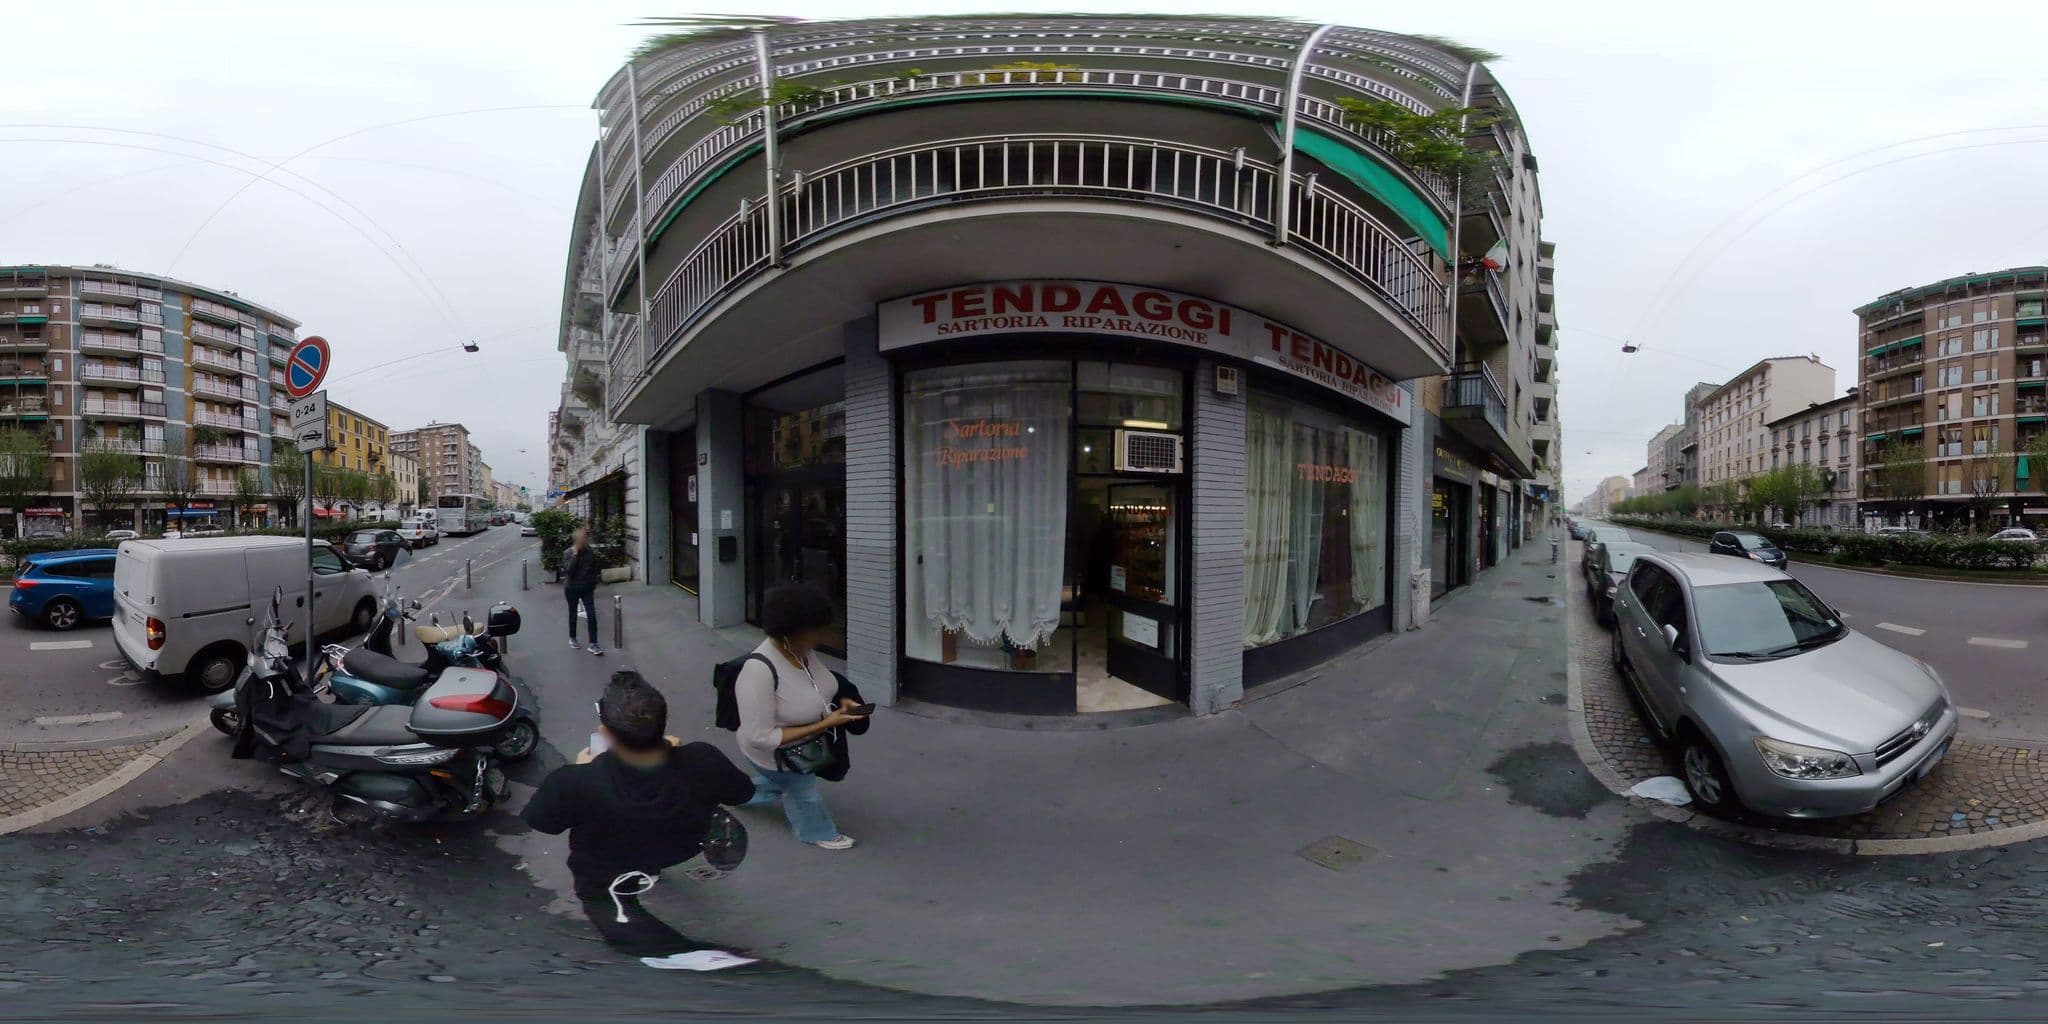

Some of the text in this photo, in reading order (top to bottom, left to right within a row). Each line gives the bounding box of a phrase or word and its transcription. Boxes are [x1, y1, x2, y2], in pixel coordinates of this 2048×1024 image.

[912, 285, 1230, 336] TENDAGGI
[937, 315, 1208, 345] SARTORIA RIPARAZIONE
[1264, 323, 1402, 407] TENDAGGI
[1279, 356, 1337, 387] SARTORIA
[296, 403, 315, 418] 0-24
[943, 418, 1021, 438] Sartoria
[938, 446, 1029, 469] Riparazione
